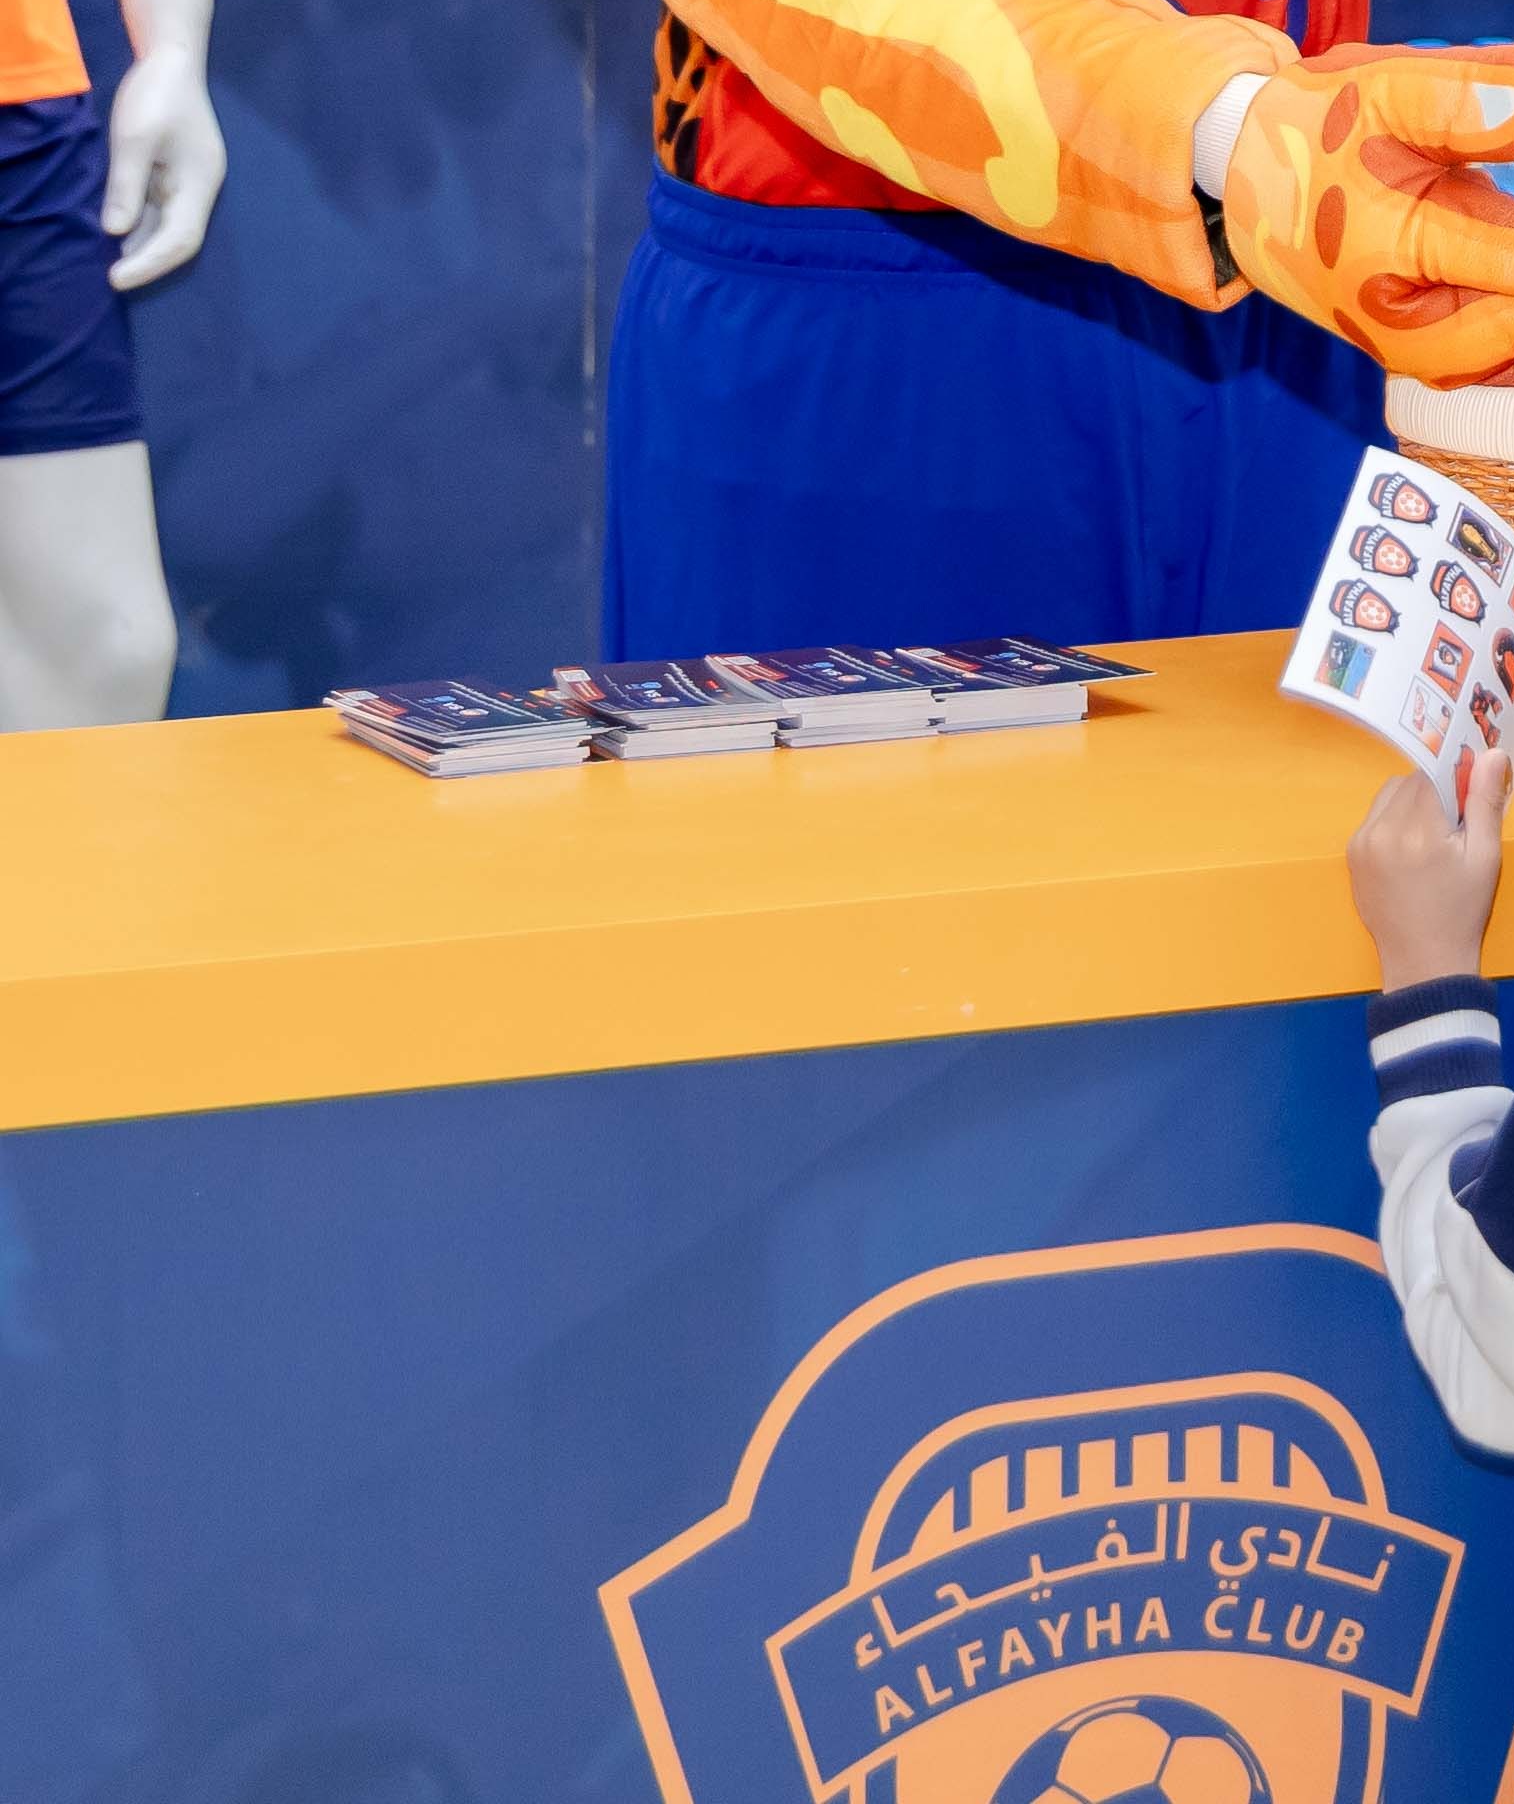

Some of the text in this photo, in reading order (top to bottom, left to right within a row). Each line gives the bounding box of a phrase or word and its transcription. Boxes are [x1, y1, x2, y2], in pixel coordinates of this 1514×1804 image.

[853, 1502, 1397, 1670] نادي الفيحاء
[873, 1595, 1367, 1734] ALFAYHA CLUB
